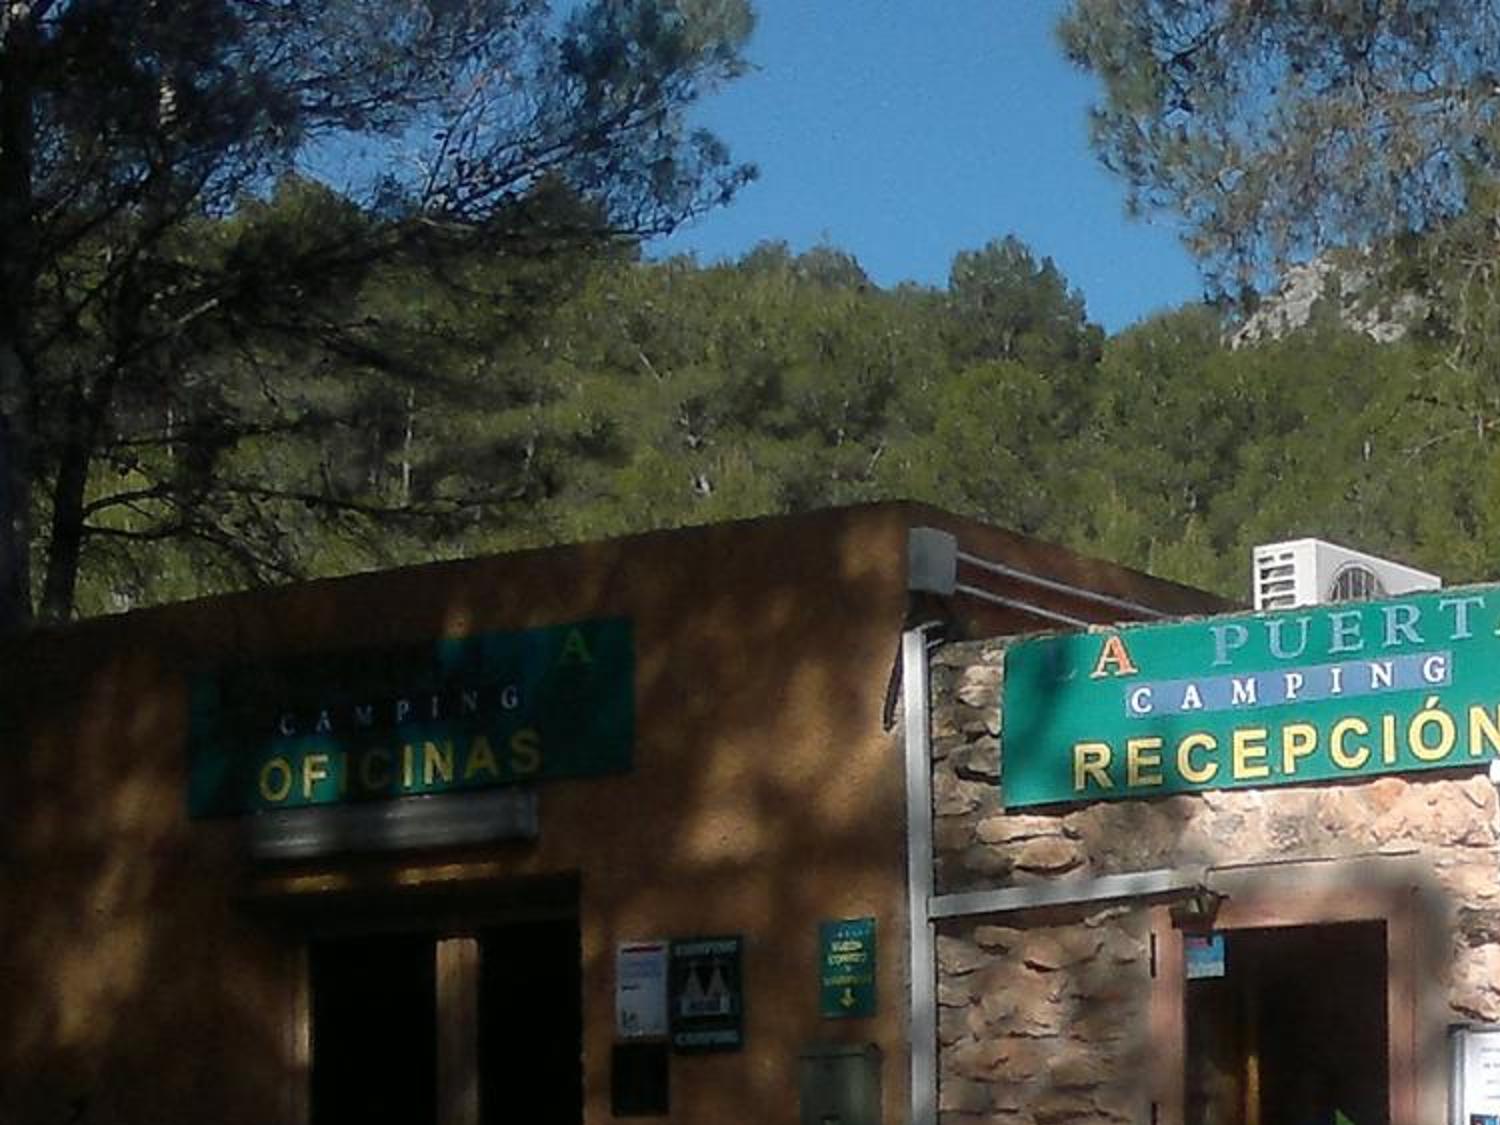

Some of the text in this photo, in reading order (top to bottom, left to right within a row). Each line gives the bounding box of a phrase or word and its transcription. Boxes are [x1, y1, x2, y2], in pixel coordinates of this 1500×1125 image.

[277, 684, 522, 736] CAMPING
[1131, 656, 1447, 715] CAMPING
[257, 726, 543, 802] OFICINAS
